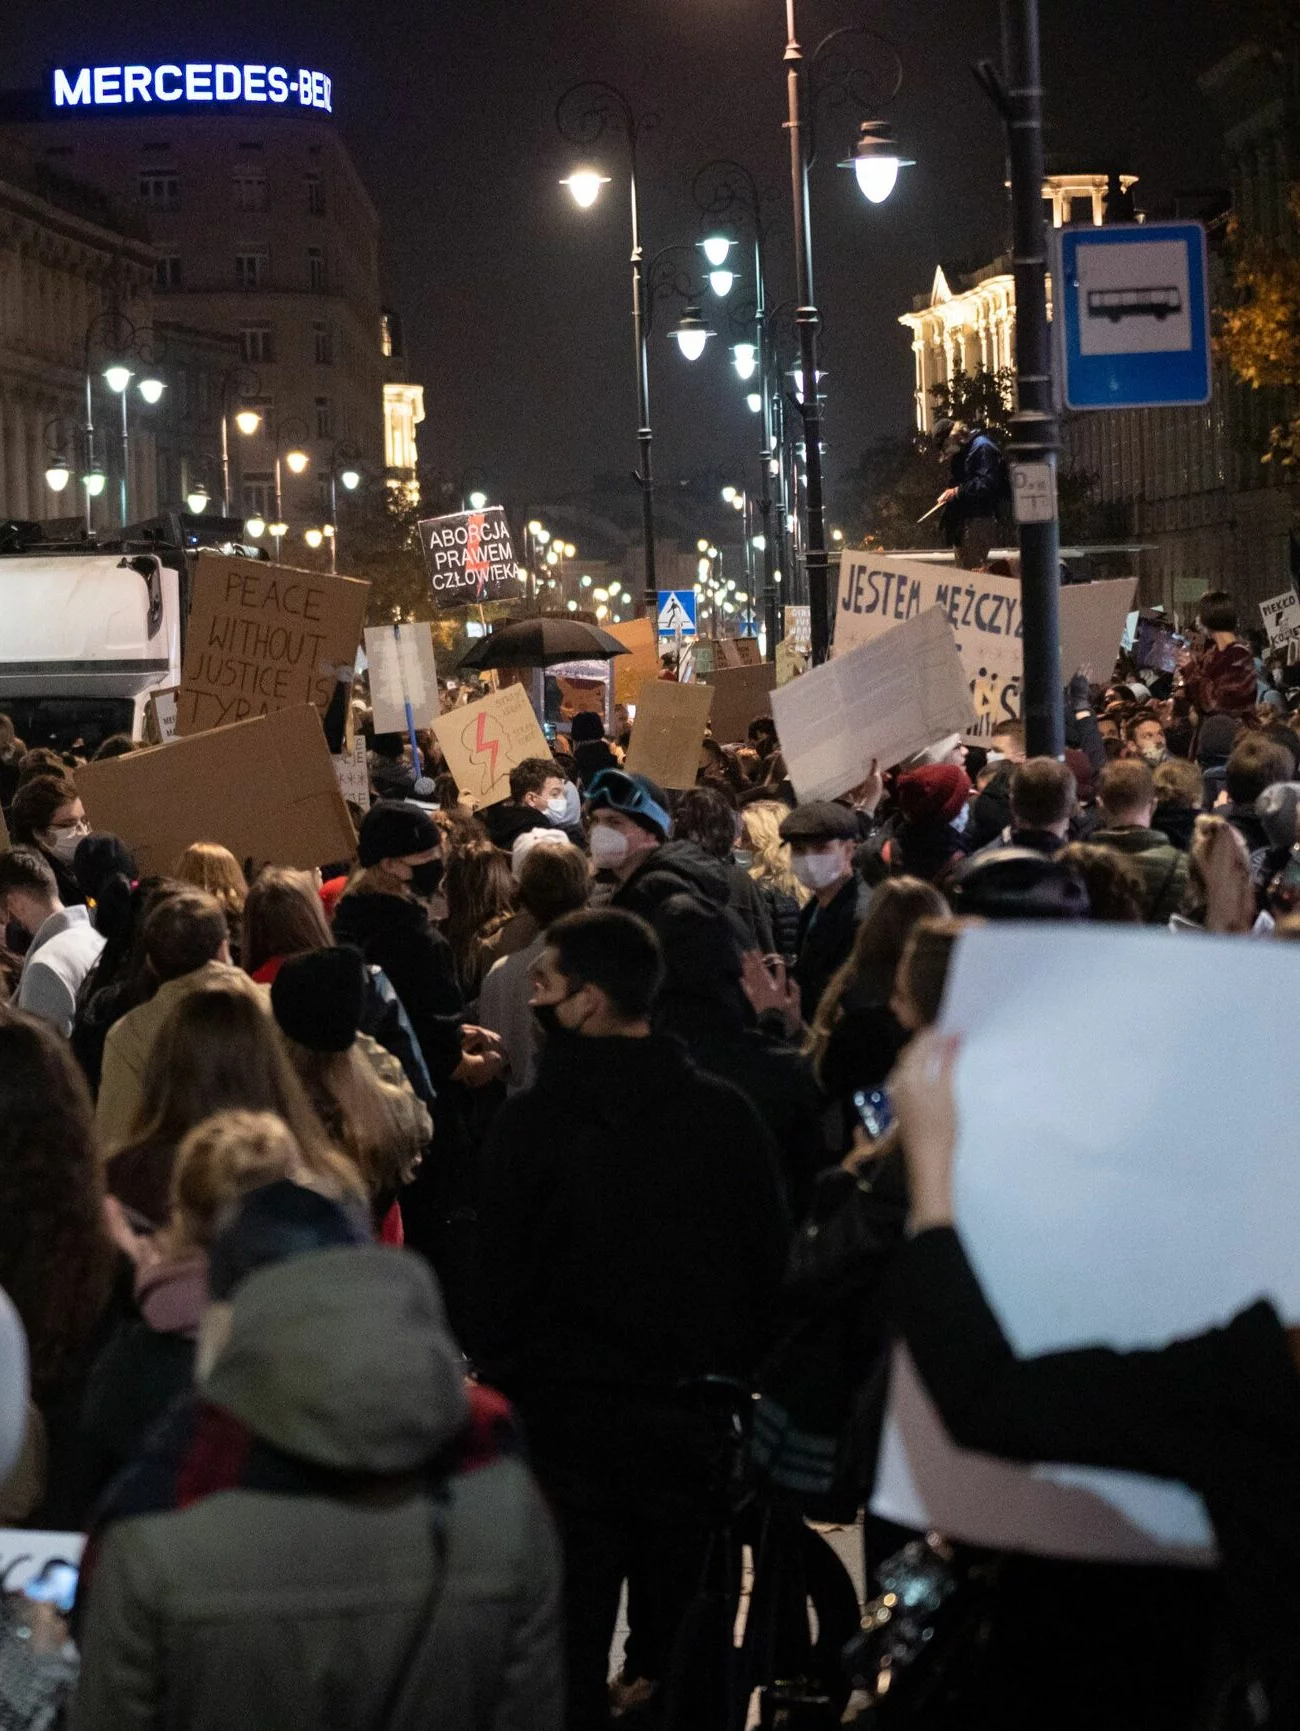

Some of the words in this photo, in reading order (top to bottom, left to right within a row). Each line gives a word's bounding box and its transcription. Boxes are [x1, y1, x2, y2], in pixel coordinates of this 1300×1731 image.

[429, 520, 511, 550] ABORCJA
[434, 541, 513, 571] PRAWEM
[225, 571, 326, 621] PEACE
[432, 561, 519, 590] CZŁOWIEKA
[842, 563, 921, 621] JESTEM
[208, 615, 327, 669] WITHOUT
[188, 654, 293, 699] JUSTICE
[305, 675, 330, 708] IS
